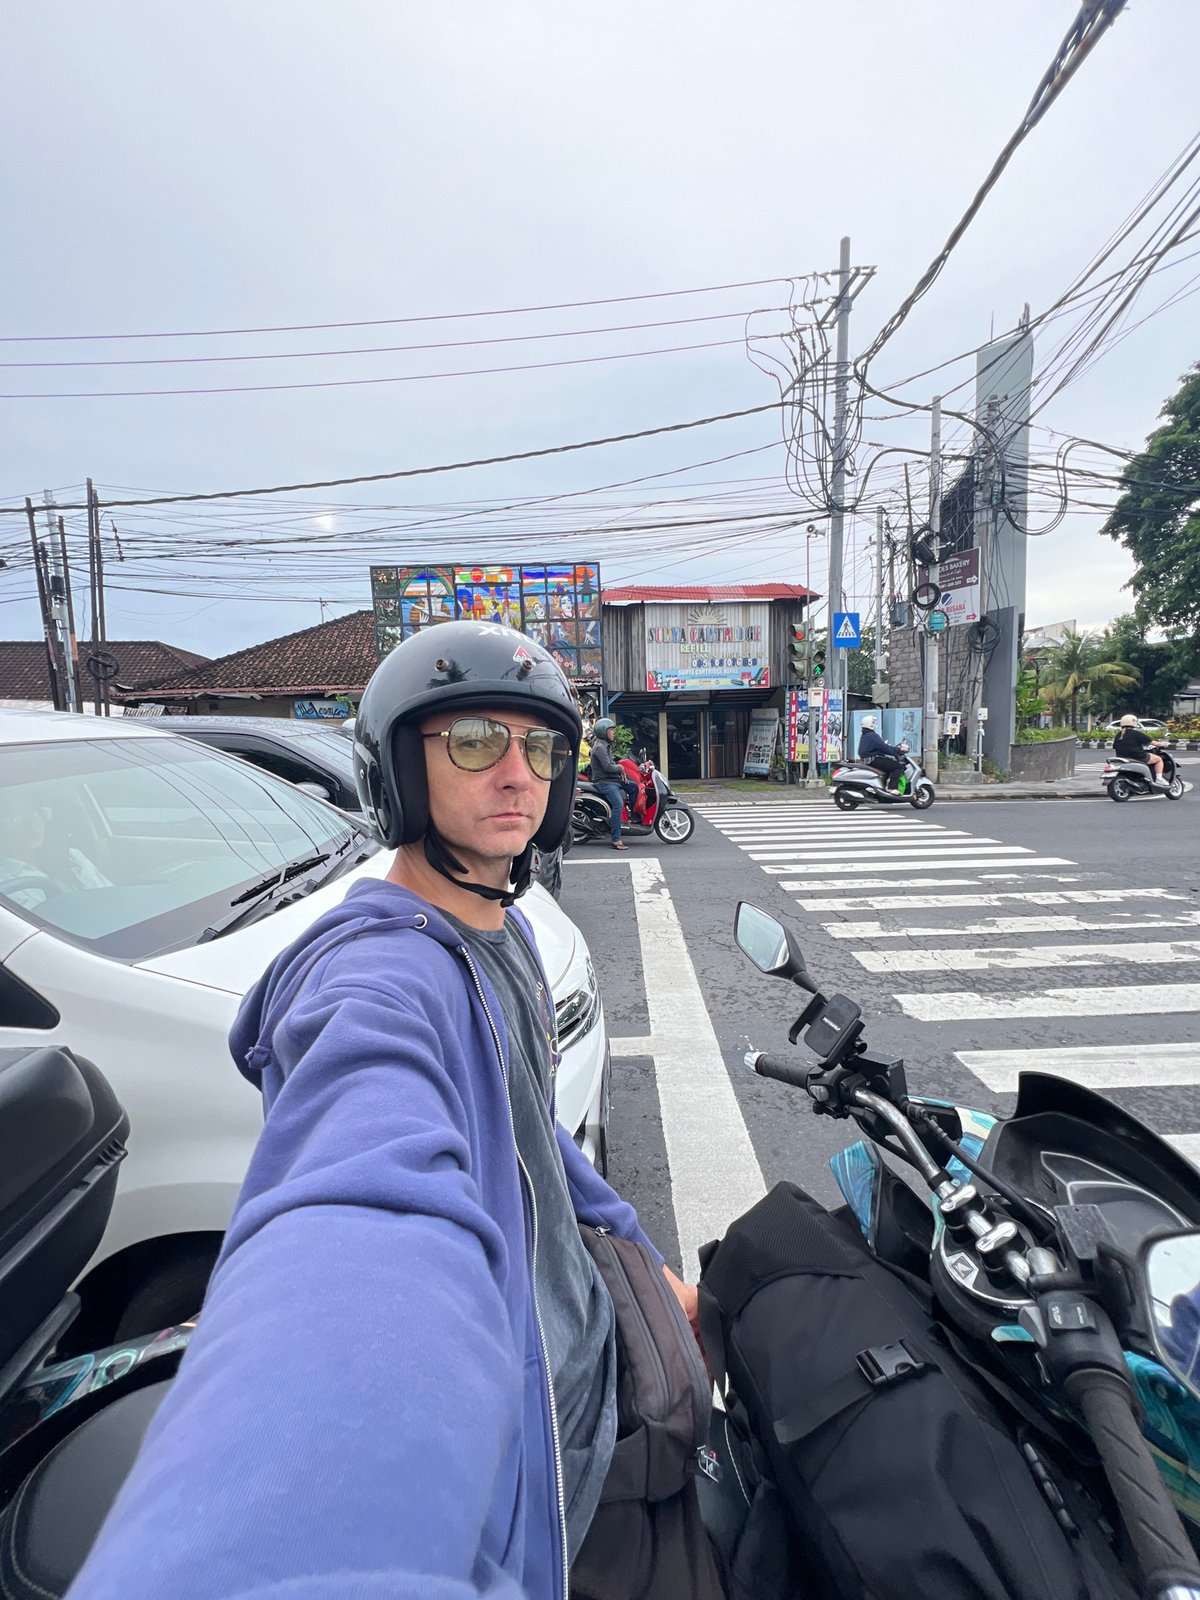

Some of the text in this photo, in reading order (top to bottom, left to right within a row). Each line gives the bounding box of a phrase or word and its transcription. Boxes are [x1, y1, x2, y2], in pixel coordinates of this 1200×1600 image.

[949, 559, 970, 569] BAKERY
[648, 626, 761, 643] SURYA CARTRIDGE
[680, 644, 710, 653] REFILL
